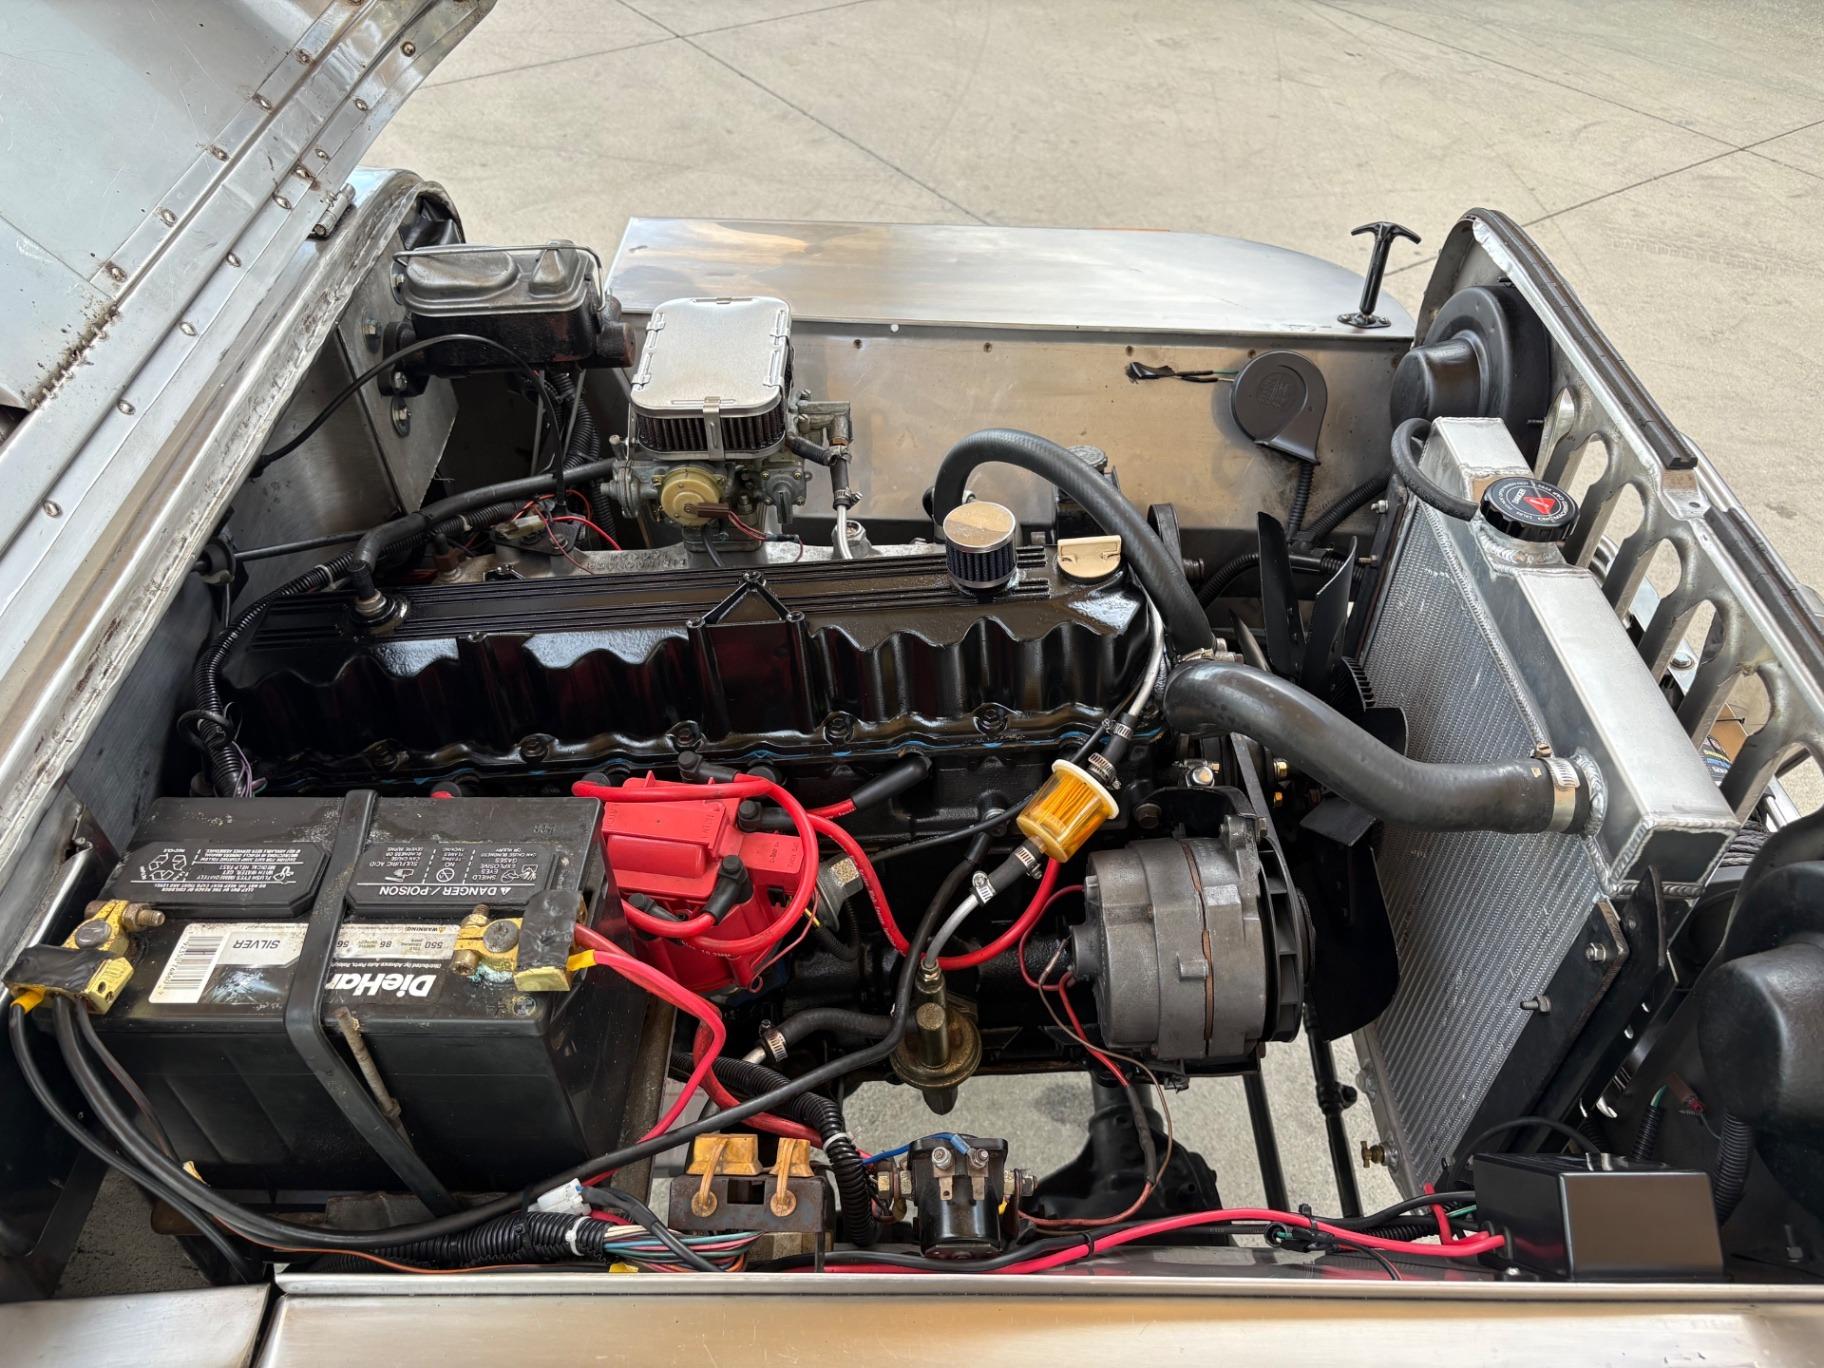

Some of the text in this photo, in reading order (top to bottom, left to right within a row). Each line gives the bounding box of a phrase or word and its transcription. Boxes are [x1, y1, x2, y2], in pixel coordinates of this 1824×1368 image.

[379, 886, 429, 895] POISON
[442, 886, 497, 895] DANGER
[233, 939, 281, 950] SILVER
[425, 941, 443, 949] 550
